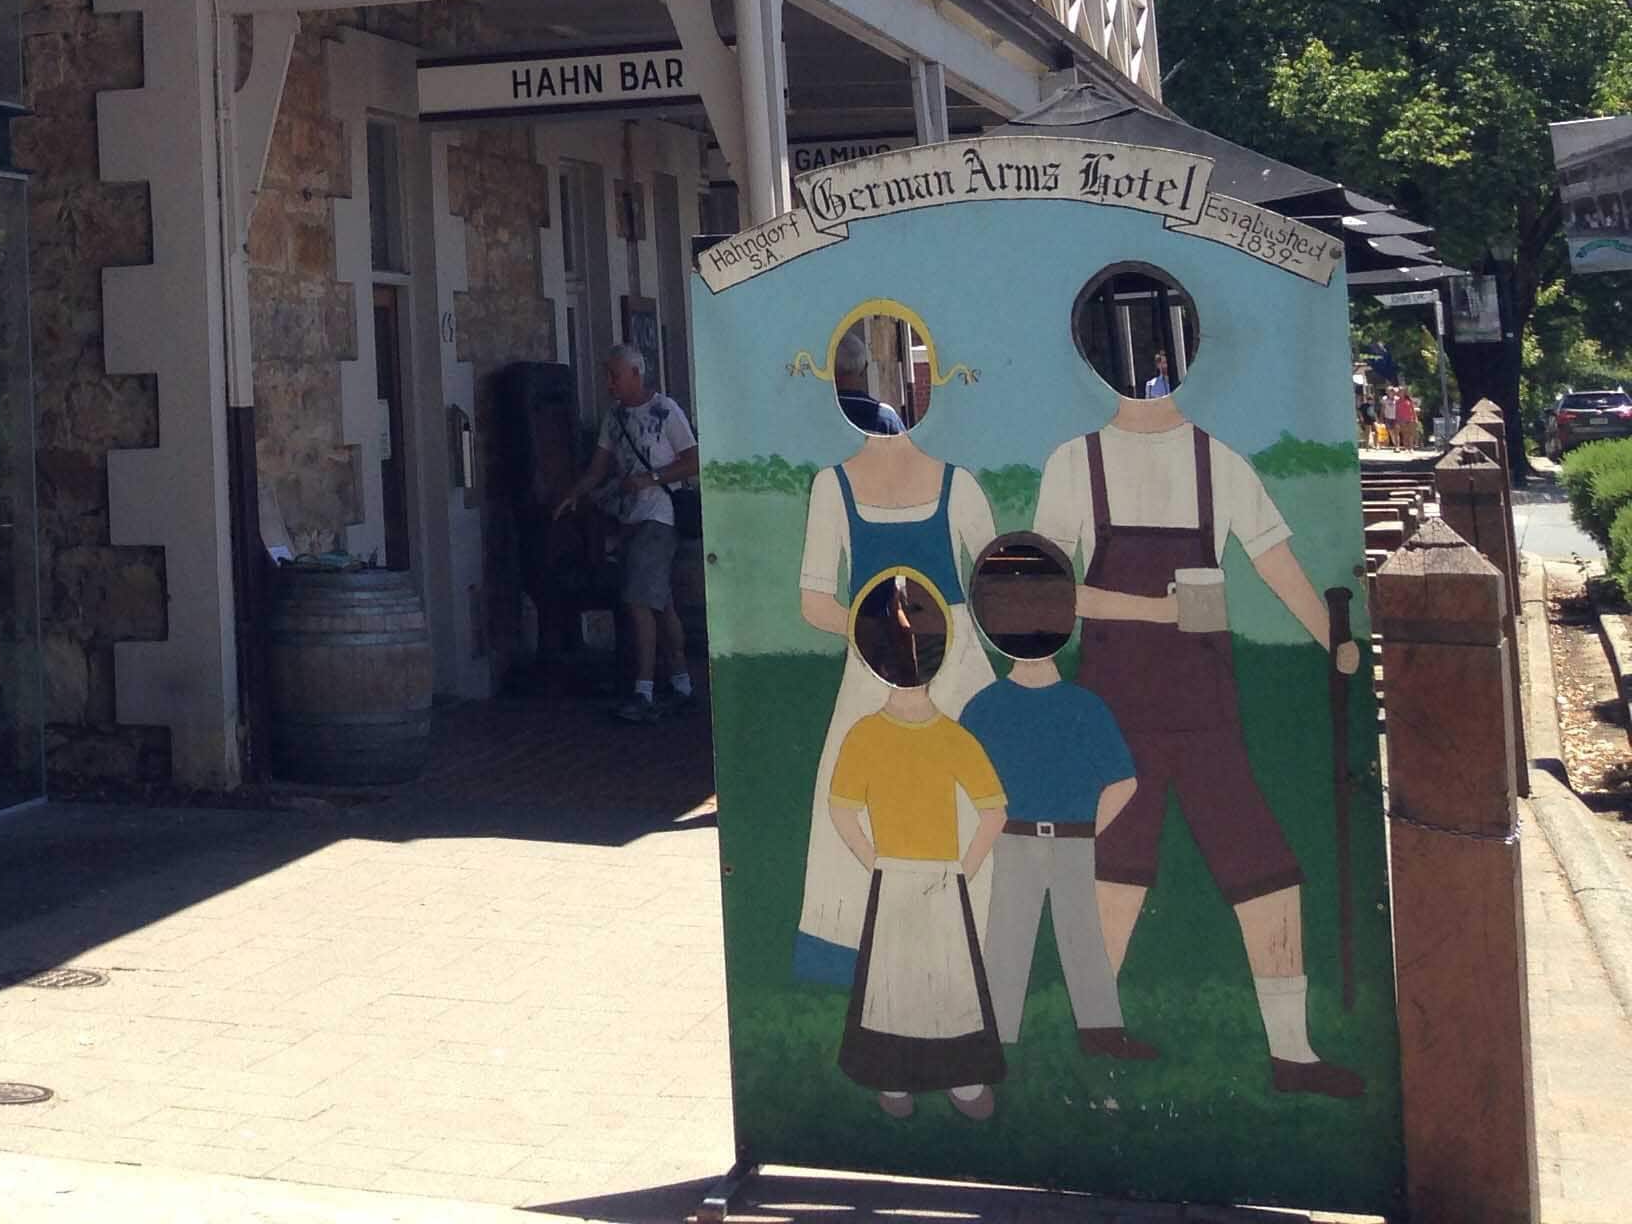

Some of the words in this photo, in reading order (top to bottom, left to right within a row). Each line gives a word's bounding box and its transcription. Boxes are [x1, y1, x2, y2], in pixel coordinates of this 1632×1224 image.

[511, 63, 604, 99] HAHN
[619, 58, 684, 92] BAR
[811, 166, 956, 222] German
[963, 148, 1062, 194] Arms
[1079, 152, 1198, 212] Hotel
[708, 212, 802, 273] Hahndorf
[749, 251, 785, 272] S.A.
